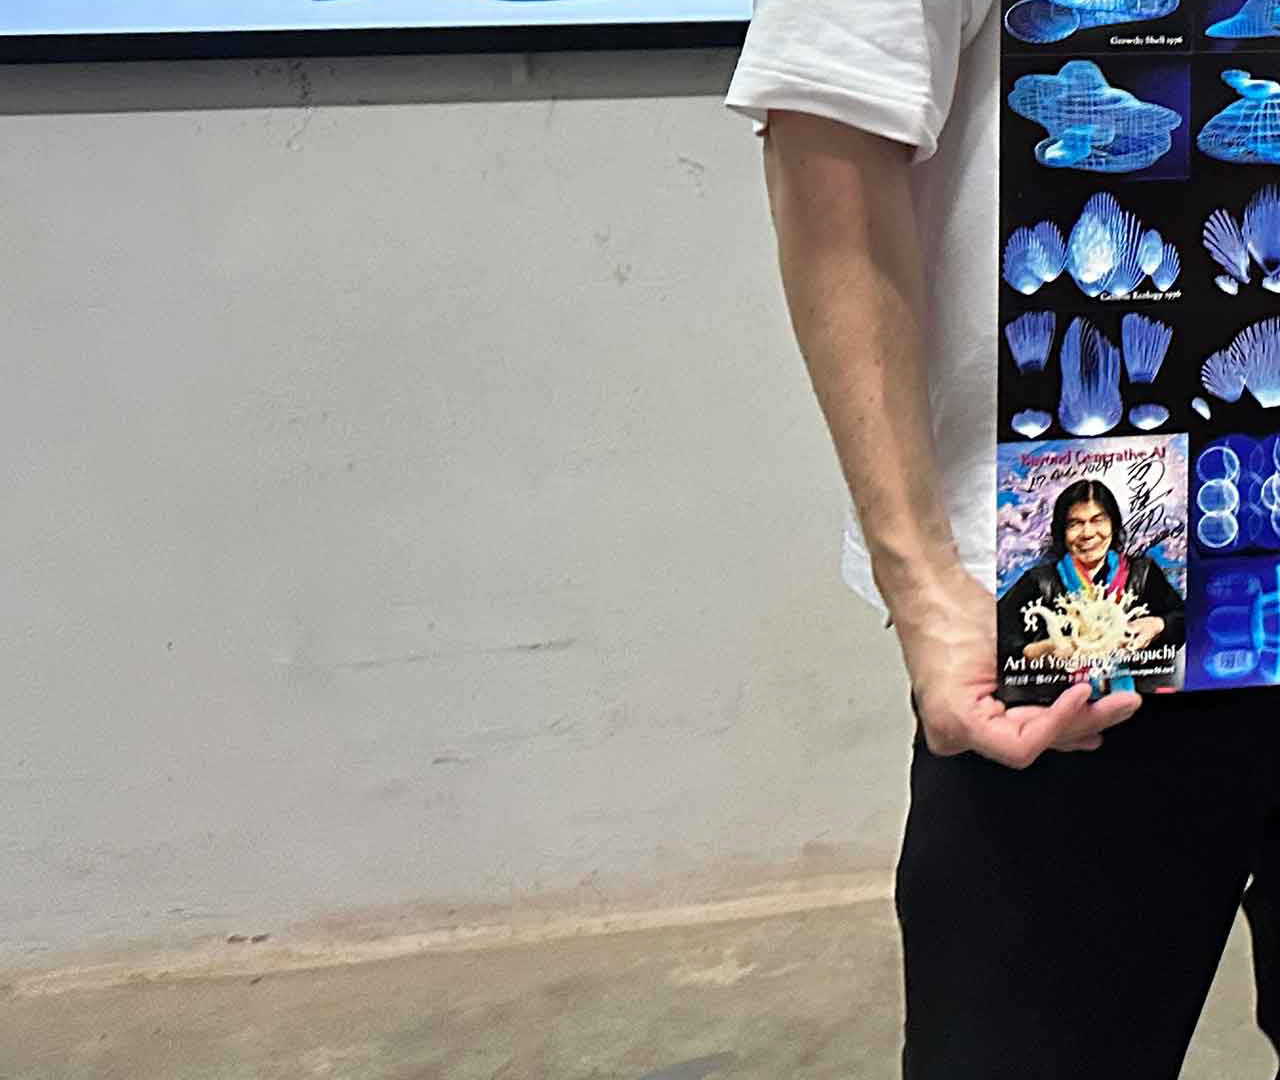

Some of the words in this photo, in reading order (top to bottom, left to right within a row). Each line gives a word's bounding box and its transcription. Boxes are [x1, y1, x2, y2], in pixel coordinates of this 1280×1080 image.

[1145, 34, 1166, 45] Shell
[1003, 655, 1026, 672] Art
[1030, 656, 1045, 670] of
